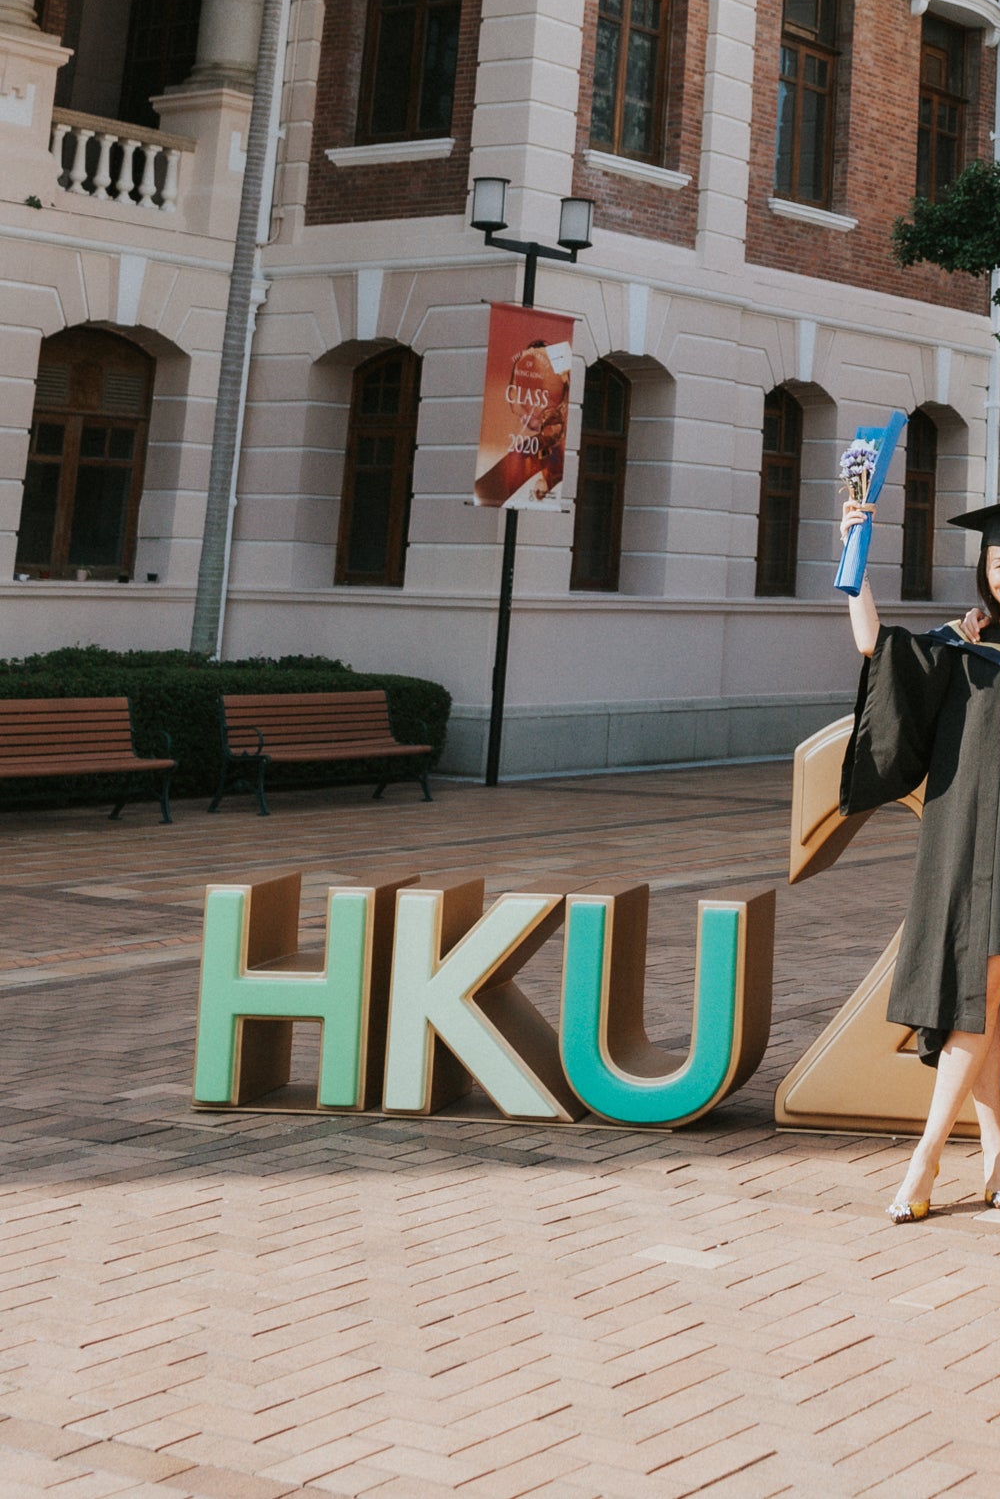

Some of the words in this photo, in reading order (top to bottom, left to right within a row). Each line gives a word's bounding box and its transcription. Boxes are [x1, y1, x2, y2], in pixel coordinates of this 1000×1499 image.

[505, 385, 549, 409] CLASS
[507, 434, 539, 455] 2020
[192, 880, 765, 1130] HKU
